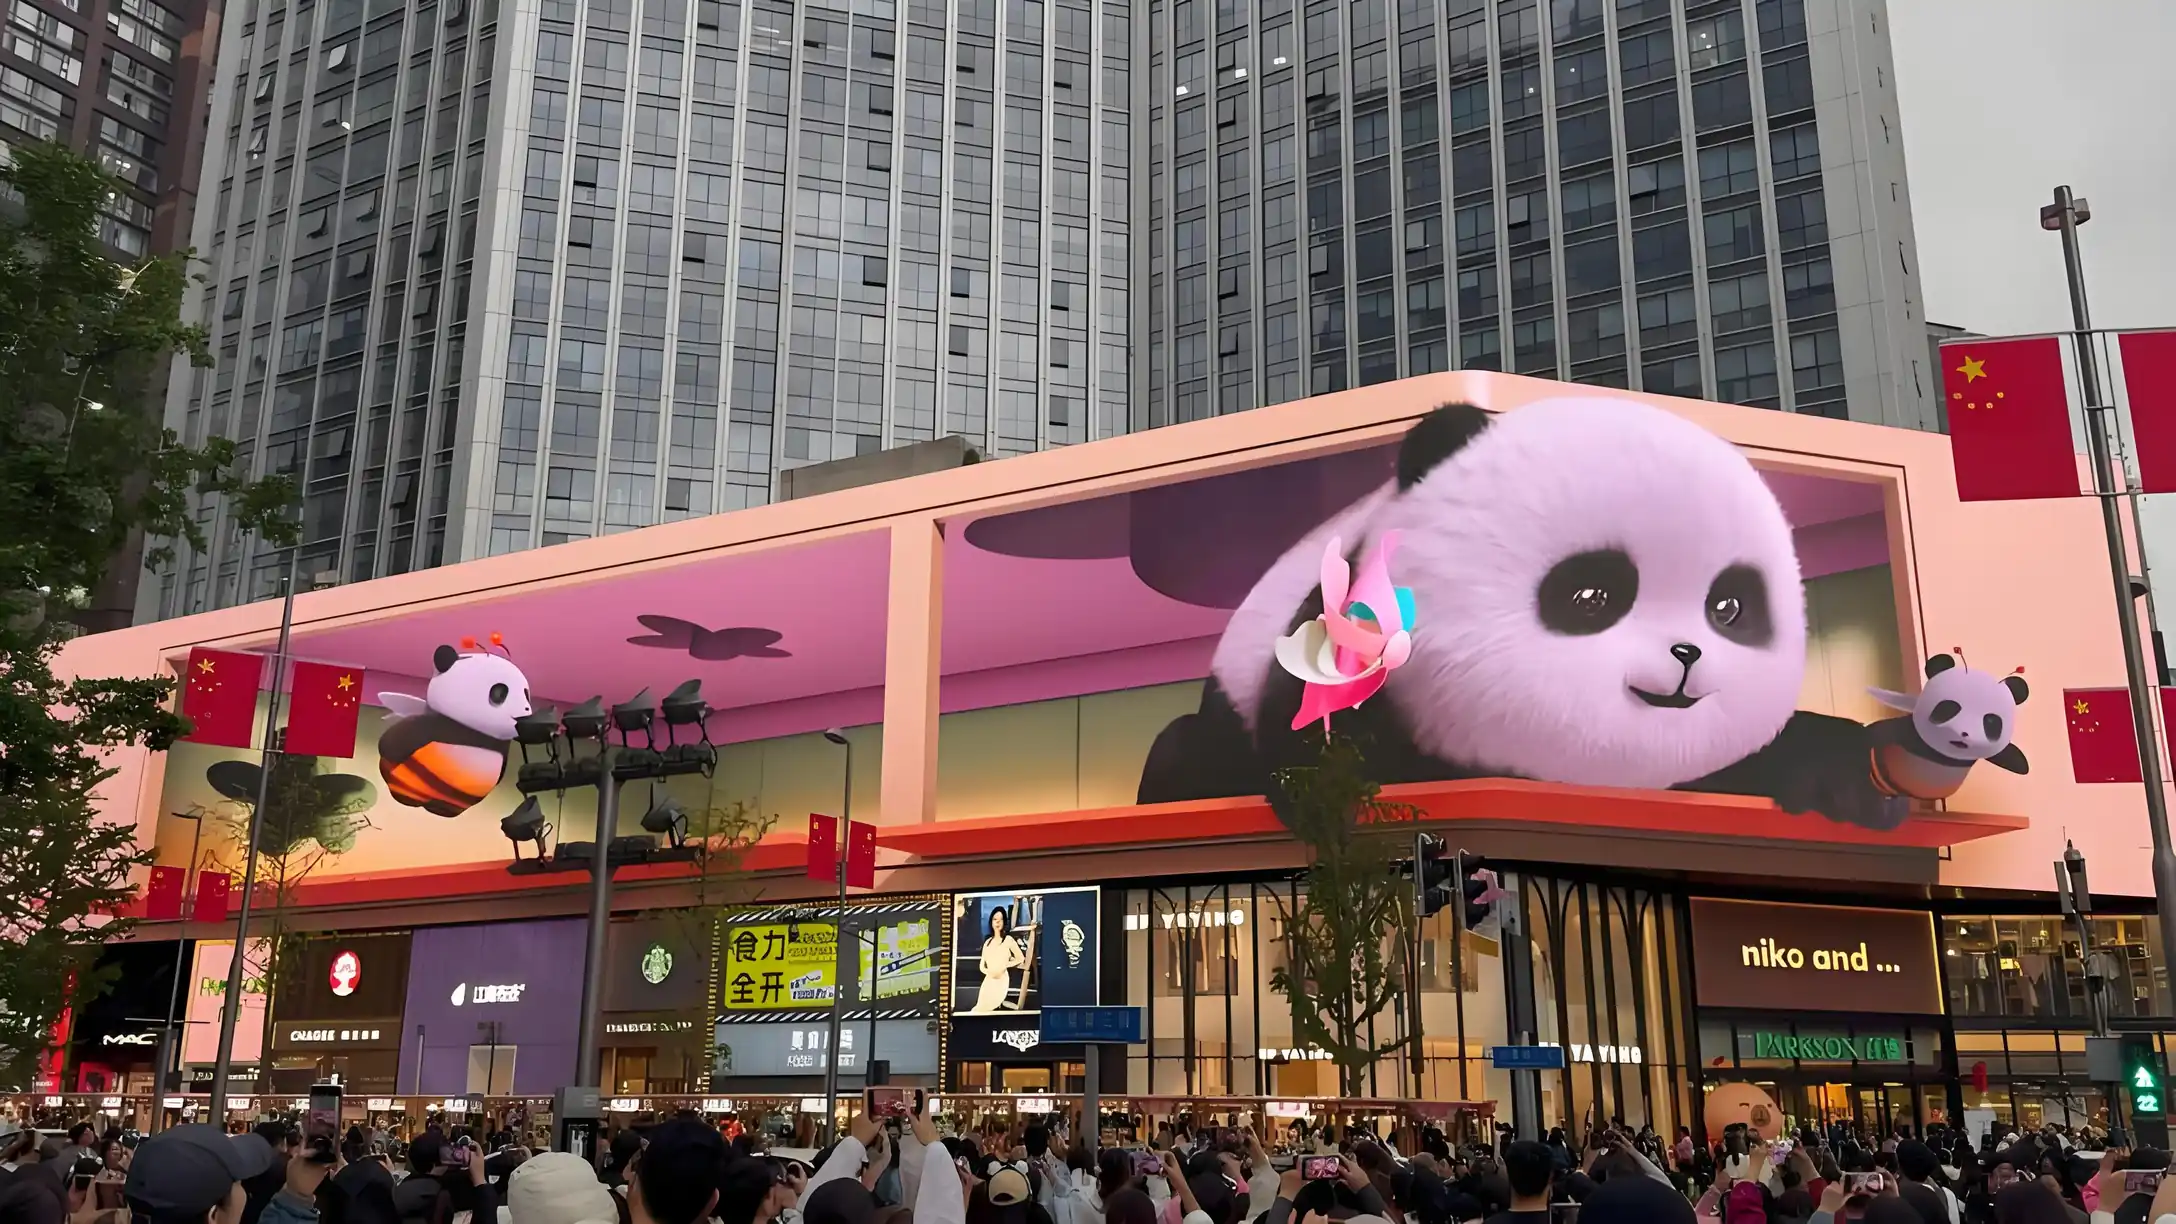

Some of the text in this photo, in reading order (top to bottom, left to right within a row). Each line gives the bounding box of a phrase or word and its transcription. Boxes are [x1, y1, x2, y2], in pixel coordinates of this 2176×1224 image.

[732, 930, 785, 962] 食力
[1742, 938, 1805, 969] niko
[1812, 942, 1869, 972] and
[730, 971, 785, 1003] 全开
[103, 1033, 158, 1046] MAC
[2136, 1094, 2159, 1112] 22
